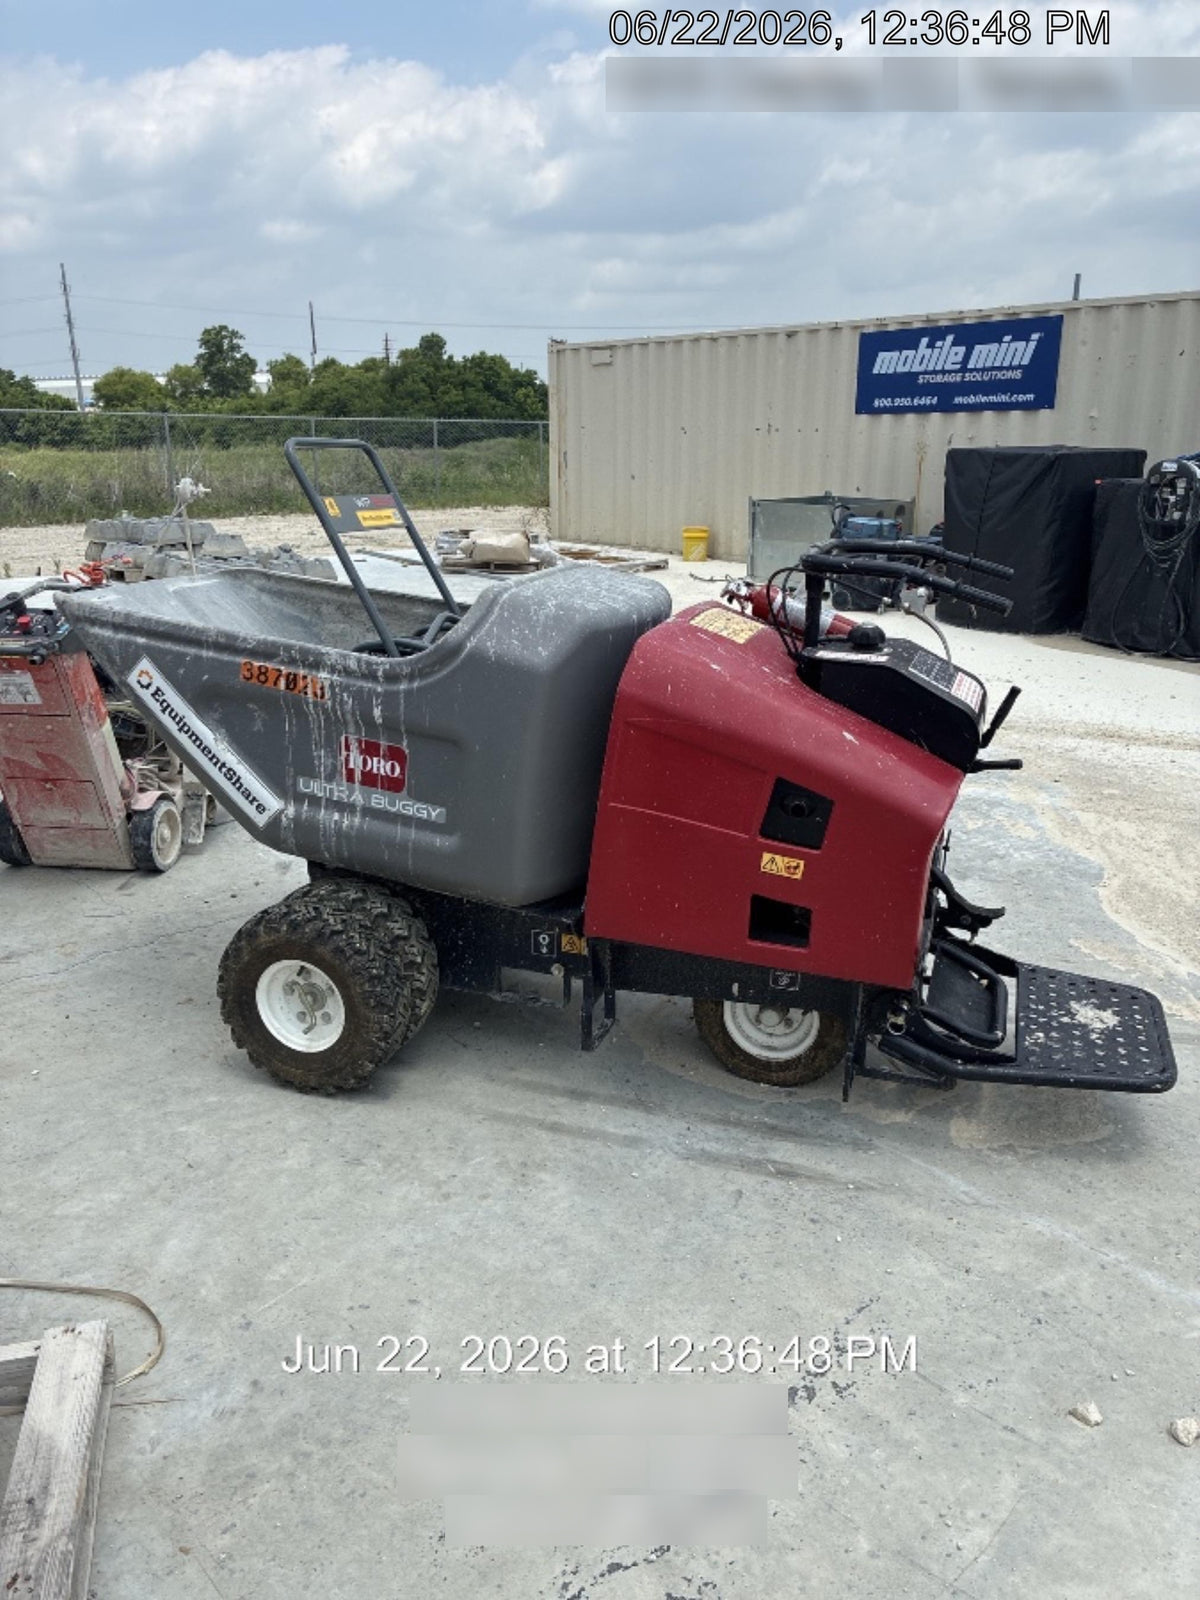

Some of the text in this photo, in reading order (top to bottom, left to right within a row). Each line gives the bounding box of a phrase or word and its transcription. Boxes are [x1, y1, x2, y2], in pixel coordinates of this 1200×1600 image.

[872, 332, 1041, 375] mobile mini
[917, 369, 1023, 384] STORAGE SOLUTIONS
[953, 393, 1035, 405] mobilemini.com
[151, 686, 267, 815] EquipmentShare
[346, 752, 401, 778] TORO
[299, 778, 441, 820] ULTRA BUGGY
